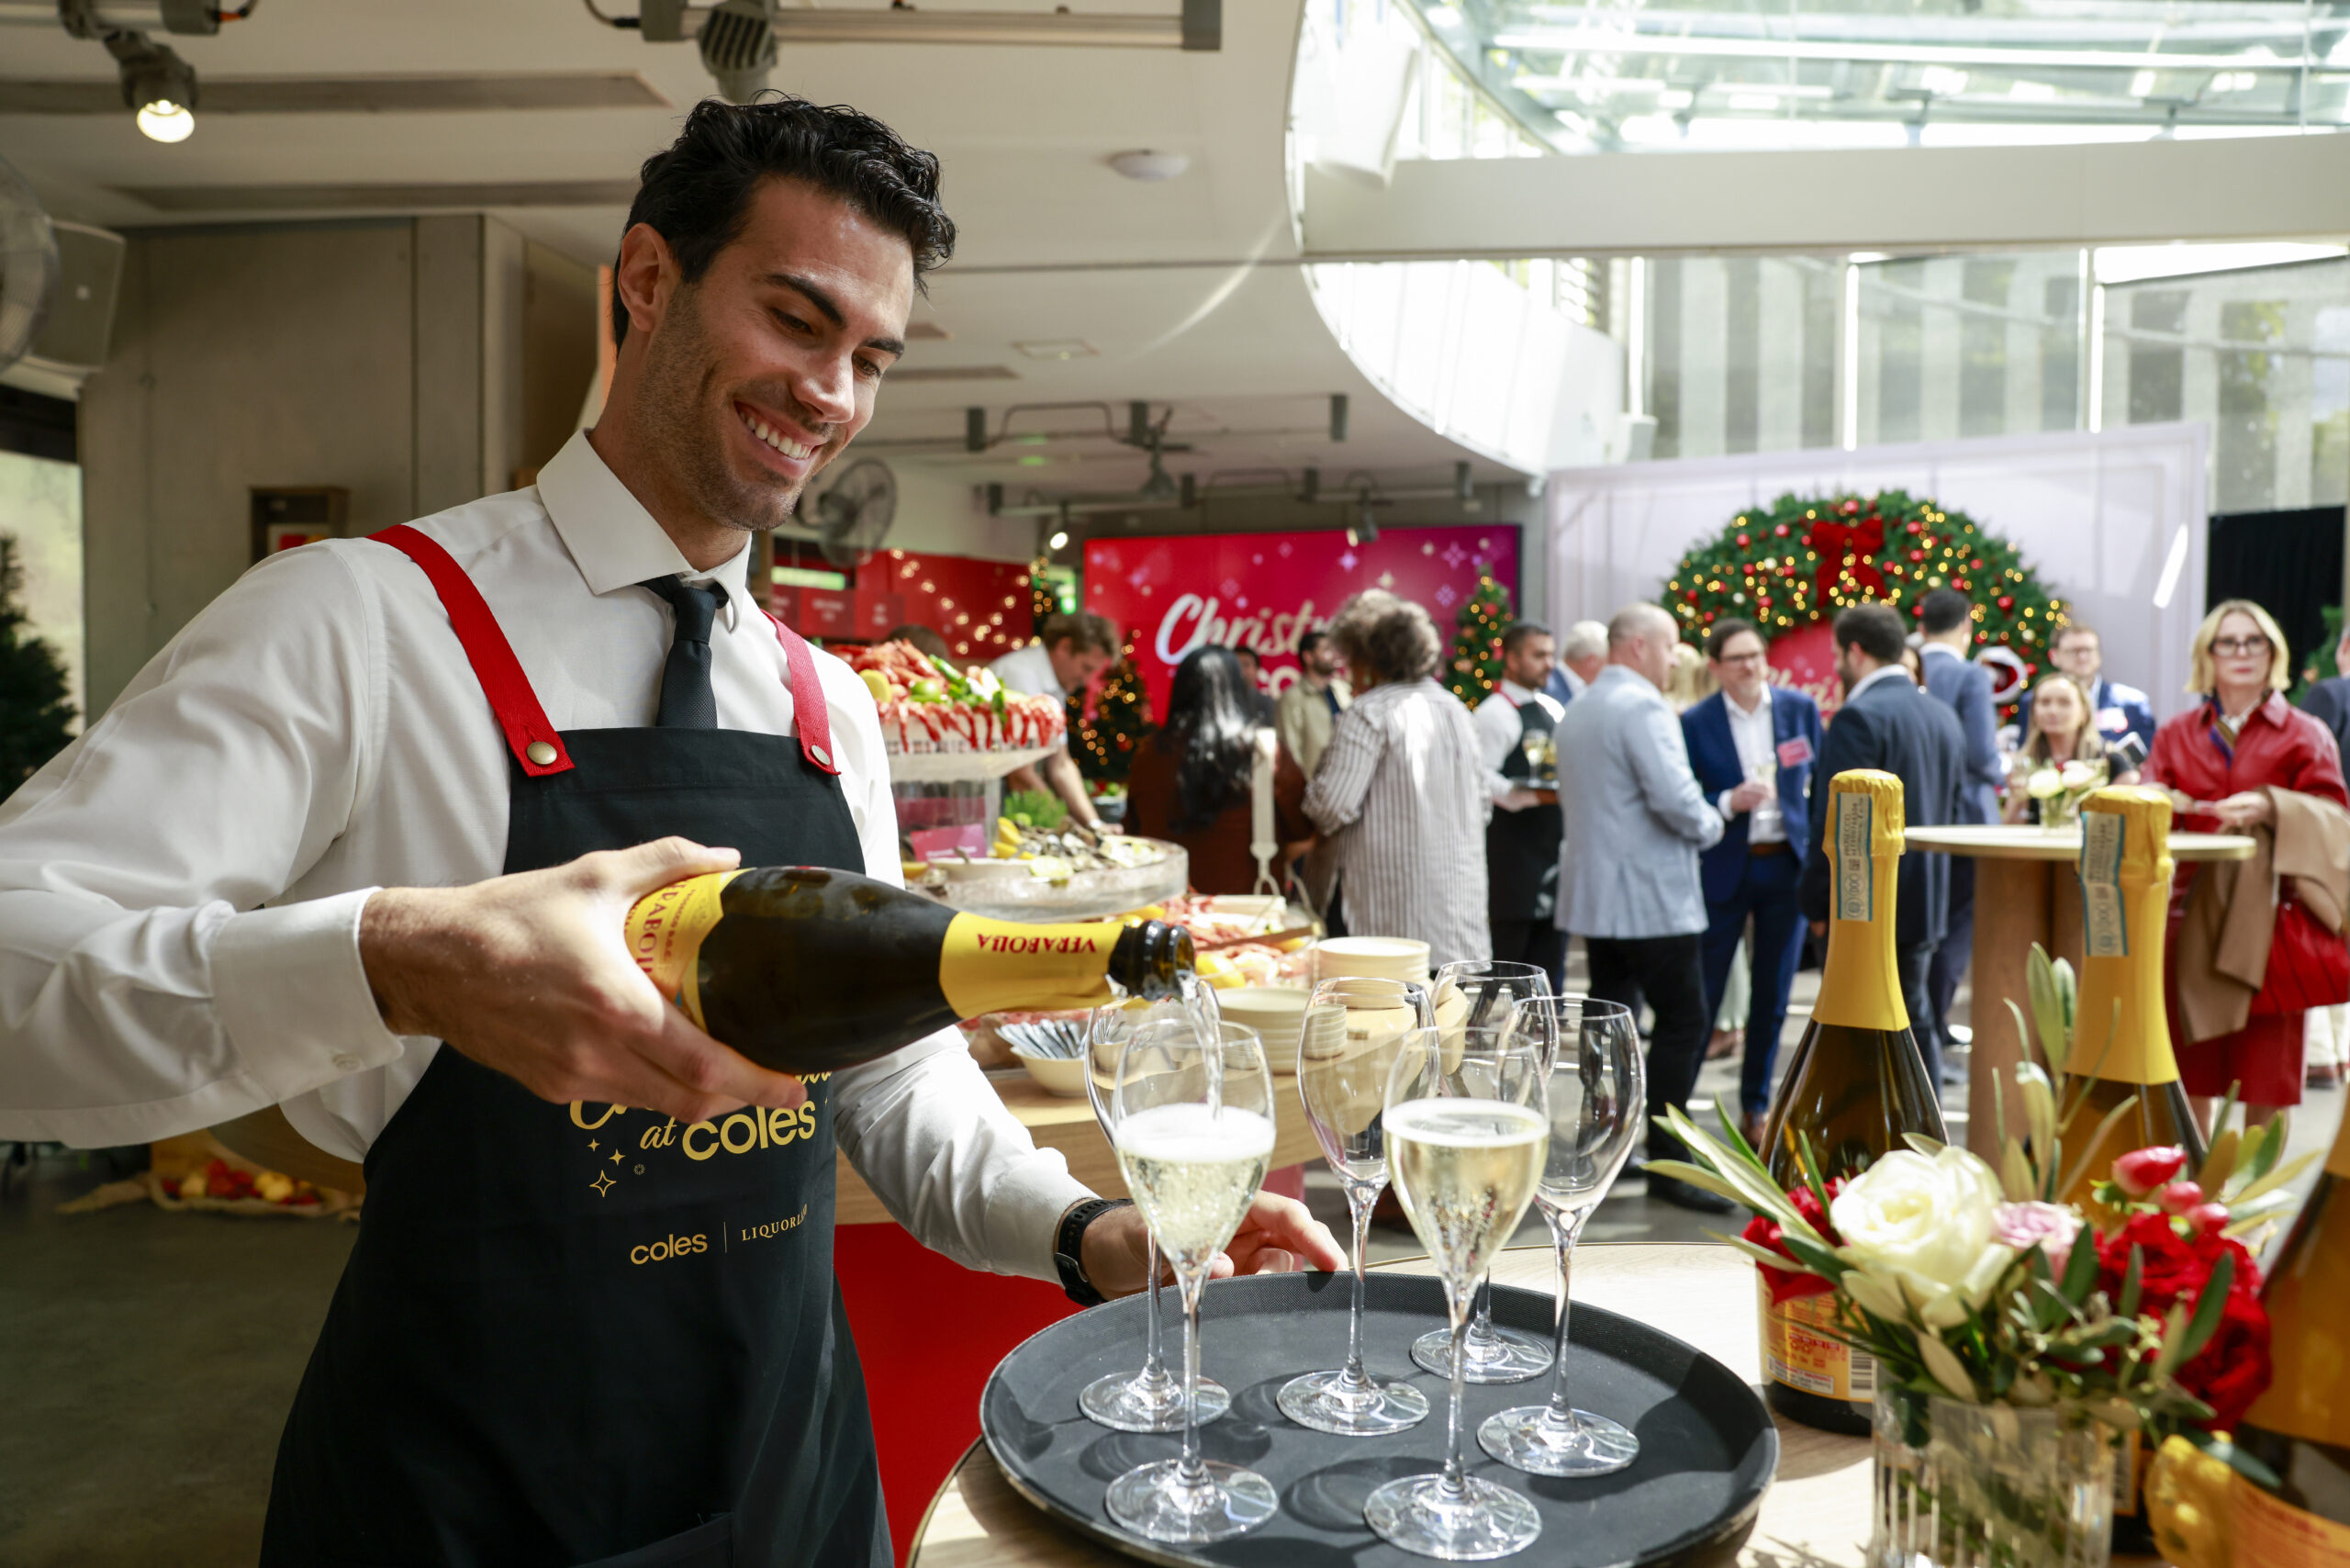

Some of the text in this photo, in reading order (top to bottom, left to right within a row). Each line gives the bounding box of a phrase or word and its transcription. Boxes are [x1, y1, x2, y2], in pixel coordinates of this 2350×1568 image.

[1155, 593, 1336, 665] Christ
[640, 1114, 677, 1149] at
[682, 1100, 816, 1161] coles
[630, 1233, 709, 1265] coles
